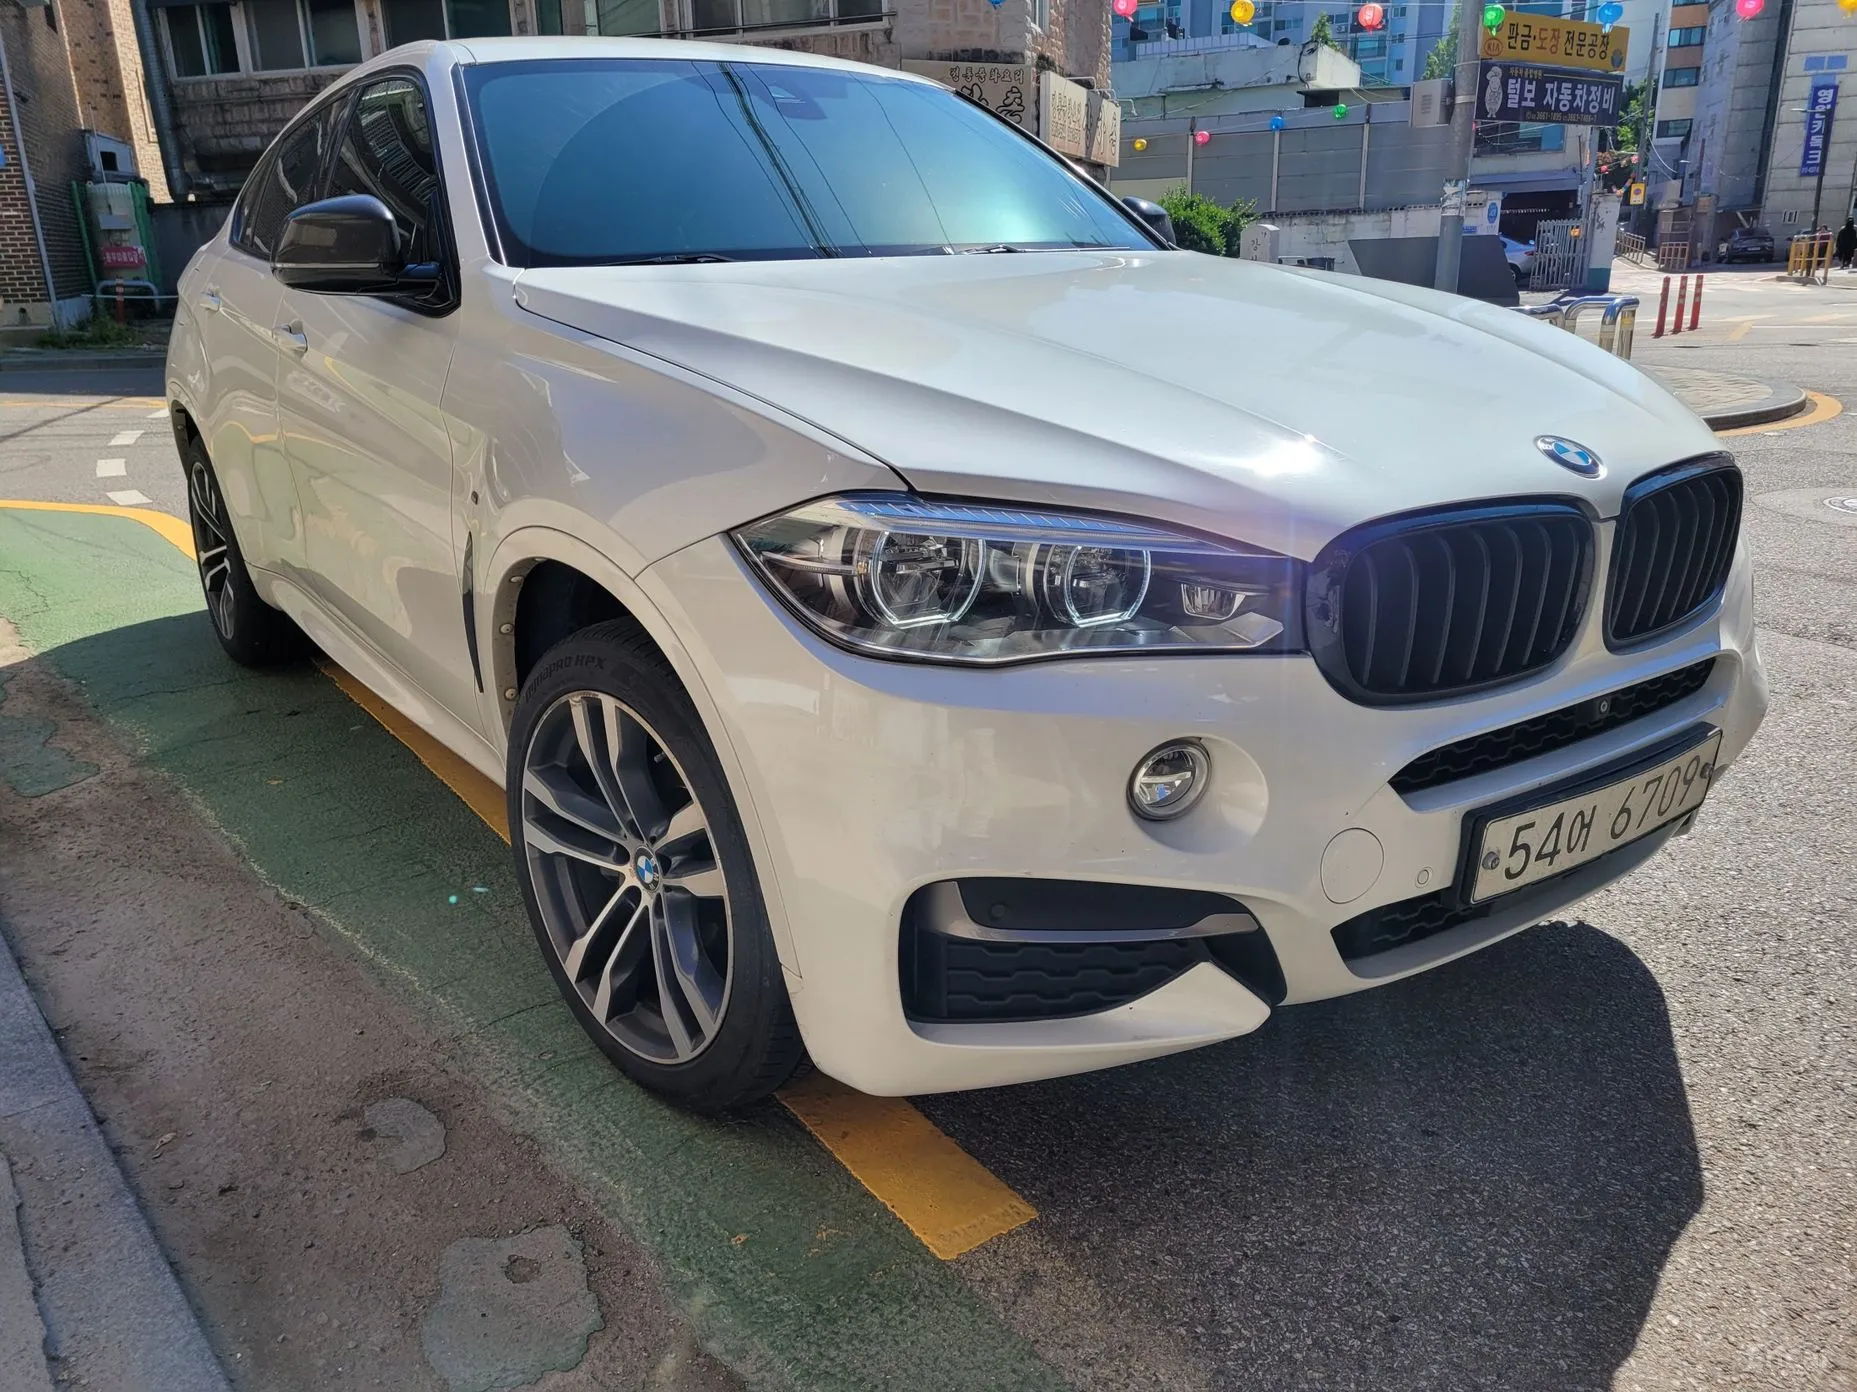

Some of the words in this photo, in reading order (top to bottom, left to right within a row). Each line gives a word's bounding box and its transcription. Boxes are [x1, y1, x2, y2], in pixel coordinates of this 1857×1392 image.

[1564, 29, 1610, 60] 전문공장
[950, 65, 1024, 85] 정통중화요리
[1507, 78, 1537, 108] 털보
[1543, 80, 1615, 115] 자동차정비
[1504, 805, 1597, 880] 54어
[1610, 755, 1700, 840] 6709
